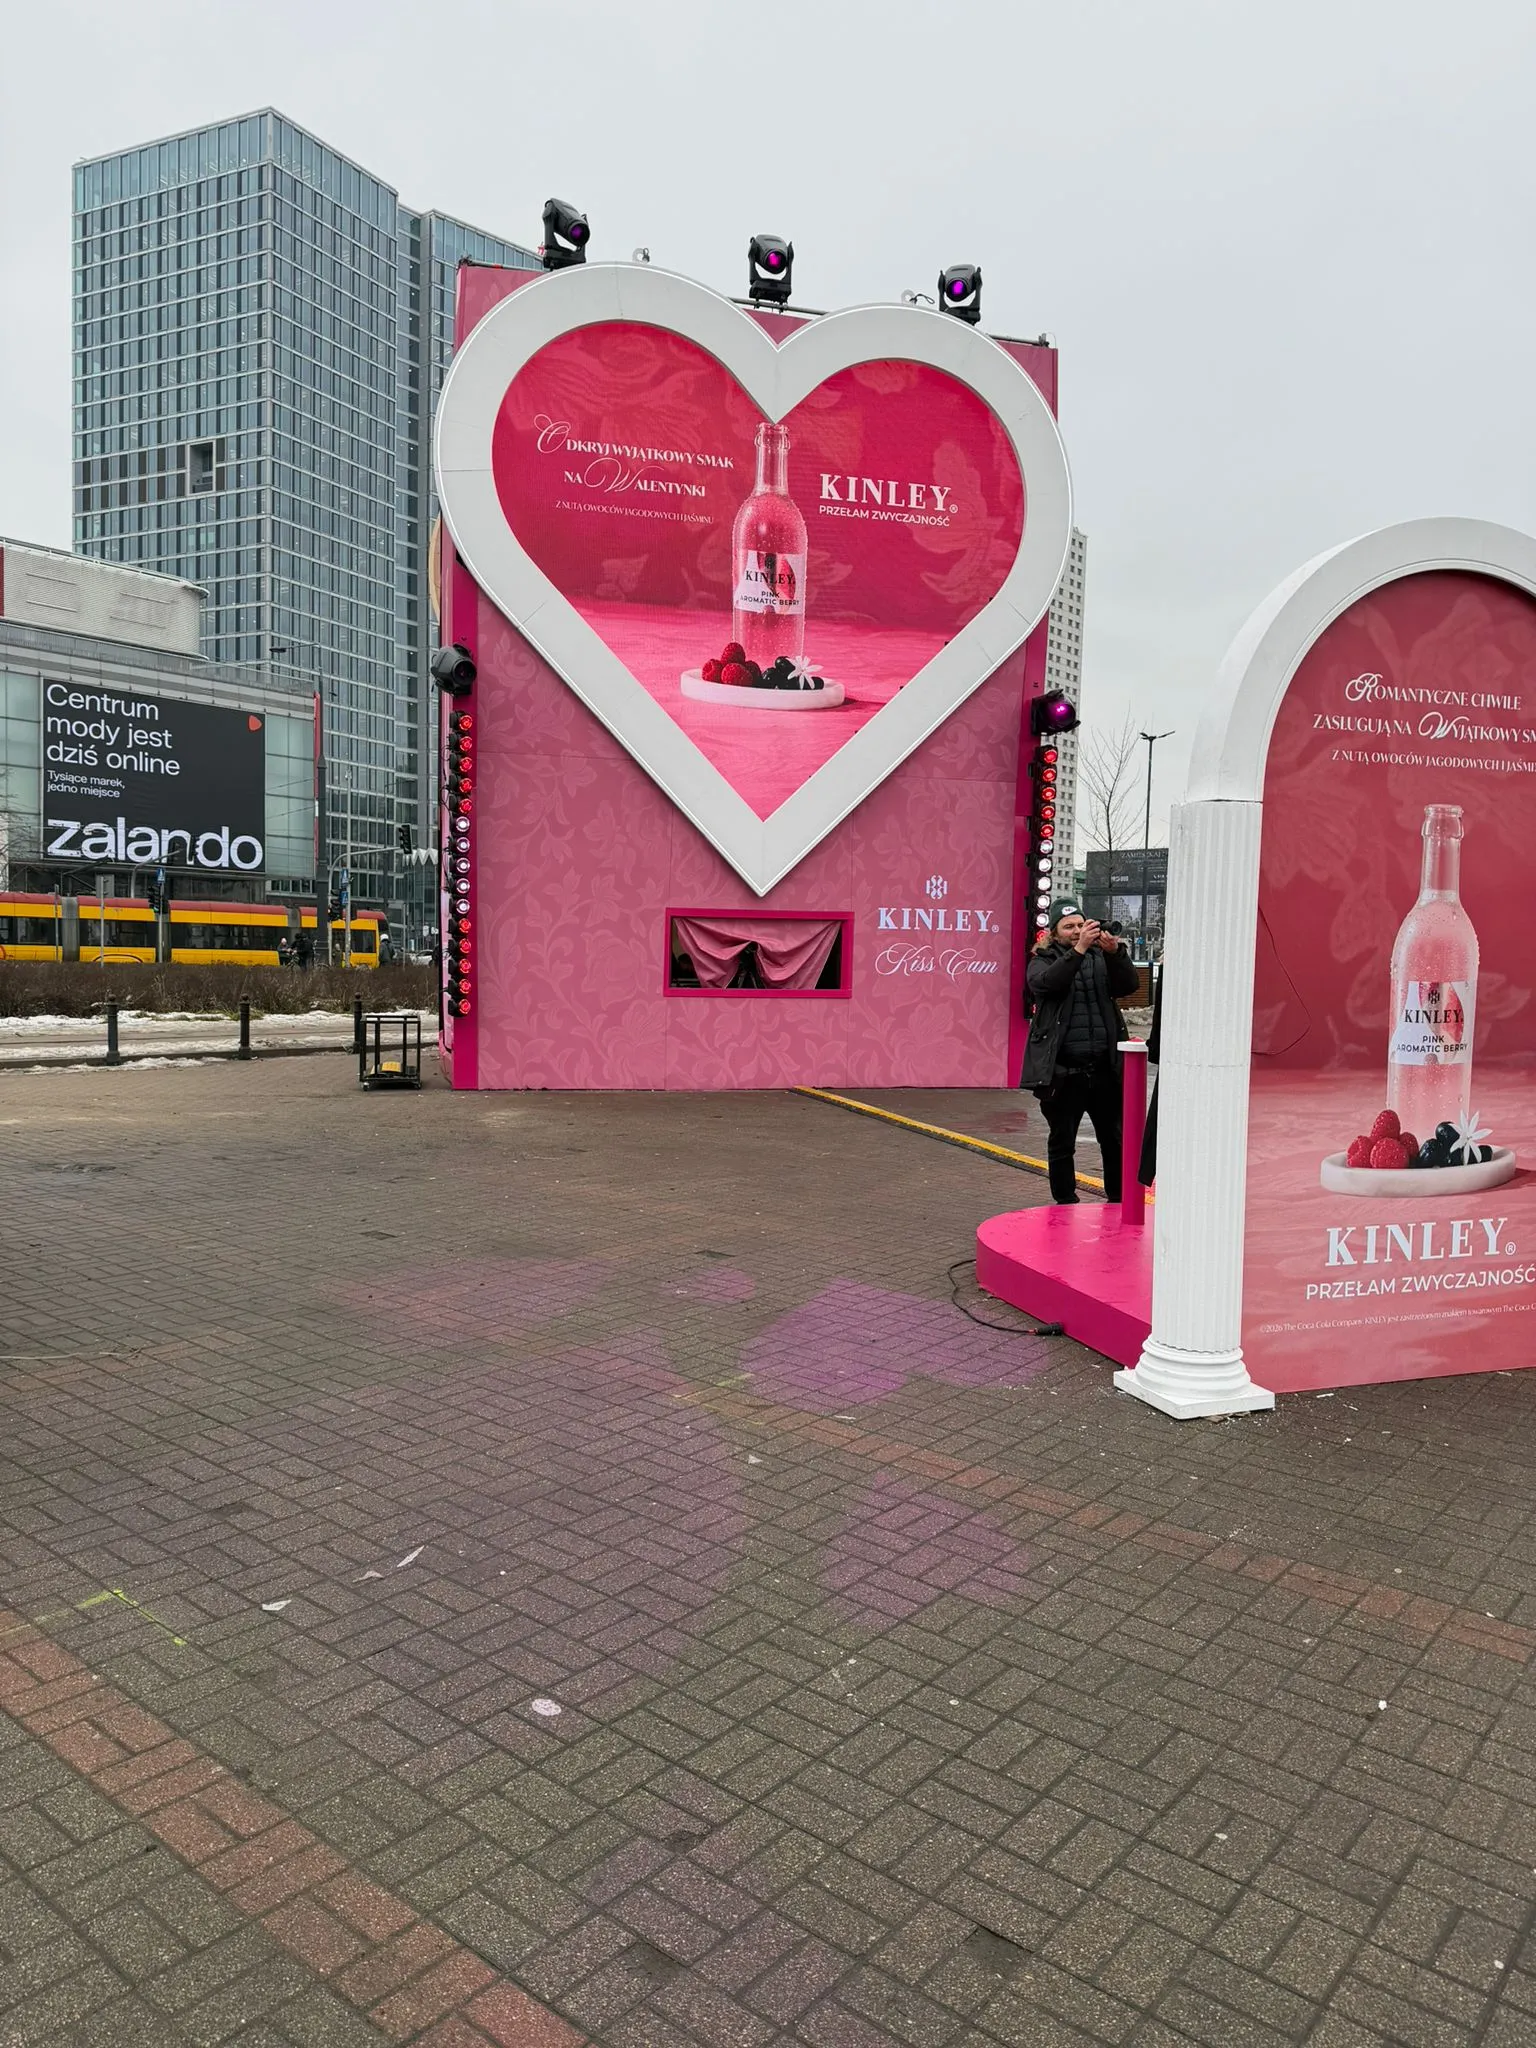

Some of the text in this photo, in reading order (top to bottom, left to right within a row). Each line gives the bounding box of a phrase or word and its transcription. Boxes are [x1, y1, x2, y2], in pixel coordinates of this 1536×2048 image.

[534, 413, 734, 470] ODKRYJ WYJĄTKOWY SMAK
[564, 457, 706, 497] NA WALENTYNKI
[819, 505, 950, 527] PRZEŁAM ZWYCZAJNOŚĆ
[740, 595, 777, 605] AROMATIC
[46, 684, 159, 720] Centrum
[1345, 672, 1522, 711] ROMANTYCZNE CHWILE
[47, 716, 173, 749] mody jest
[1393, 719, 1412, 735] NA
[1418, 711, 1521, 743] WYJĄTKOWY
[46, 741, 181, 776] dziś online
[1332, 750, 1339, 761] Z
[1342, 750, 1369, 765] NUTĄ
[1371, 752, 1425, 765] OWOCÓW
[1425, 755, 1499, 771] JAGODOWYCH
[47, 769, 126, 789] Tysiące marek,
[47, 780, 121, 798] jedno miejsce
[47, 816, 263, 870] zalando
[875, 942, 998, 982] Kiss Cam
[1396, 1043, 1468, 1053] AROMATIC BERRY
[1422, 1035, 1445, 1043] PINK
[1306, 1263, 1536, 1300] PRZEŁAM ZWYCZAJNOŚĆ
[1283, 1322, 1296, 1331] The
[1297, 1322, 1315, 1330] Coca
[1316, 1320, 1332, 1329] Cola
[1502, 1304, 1514, 1313] The
[1514, 1303, 1530, 1311] Coca
